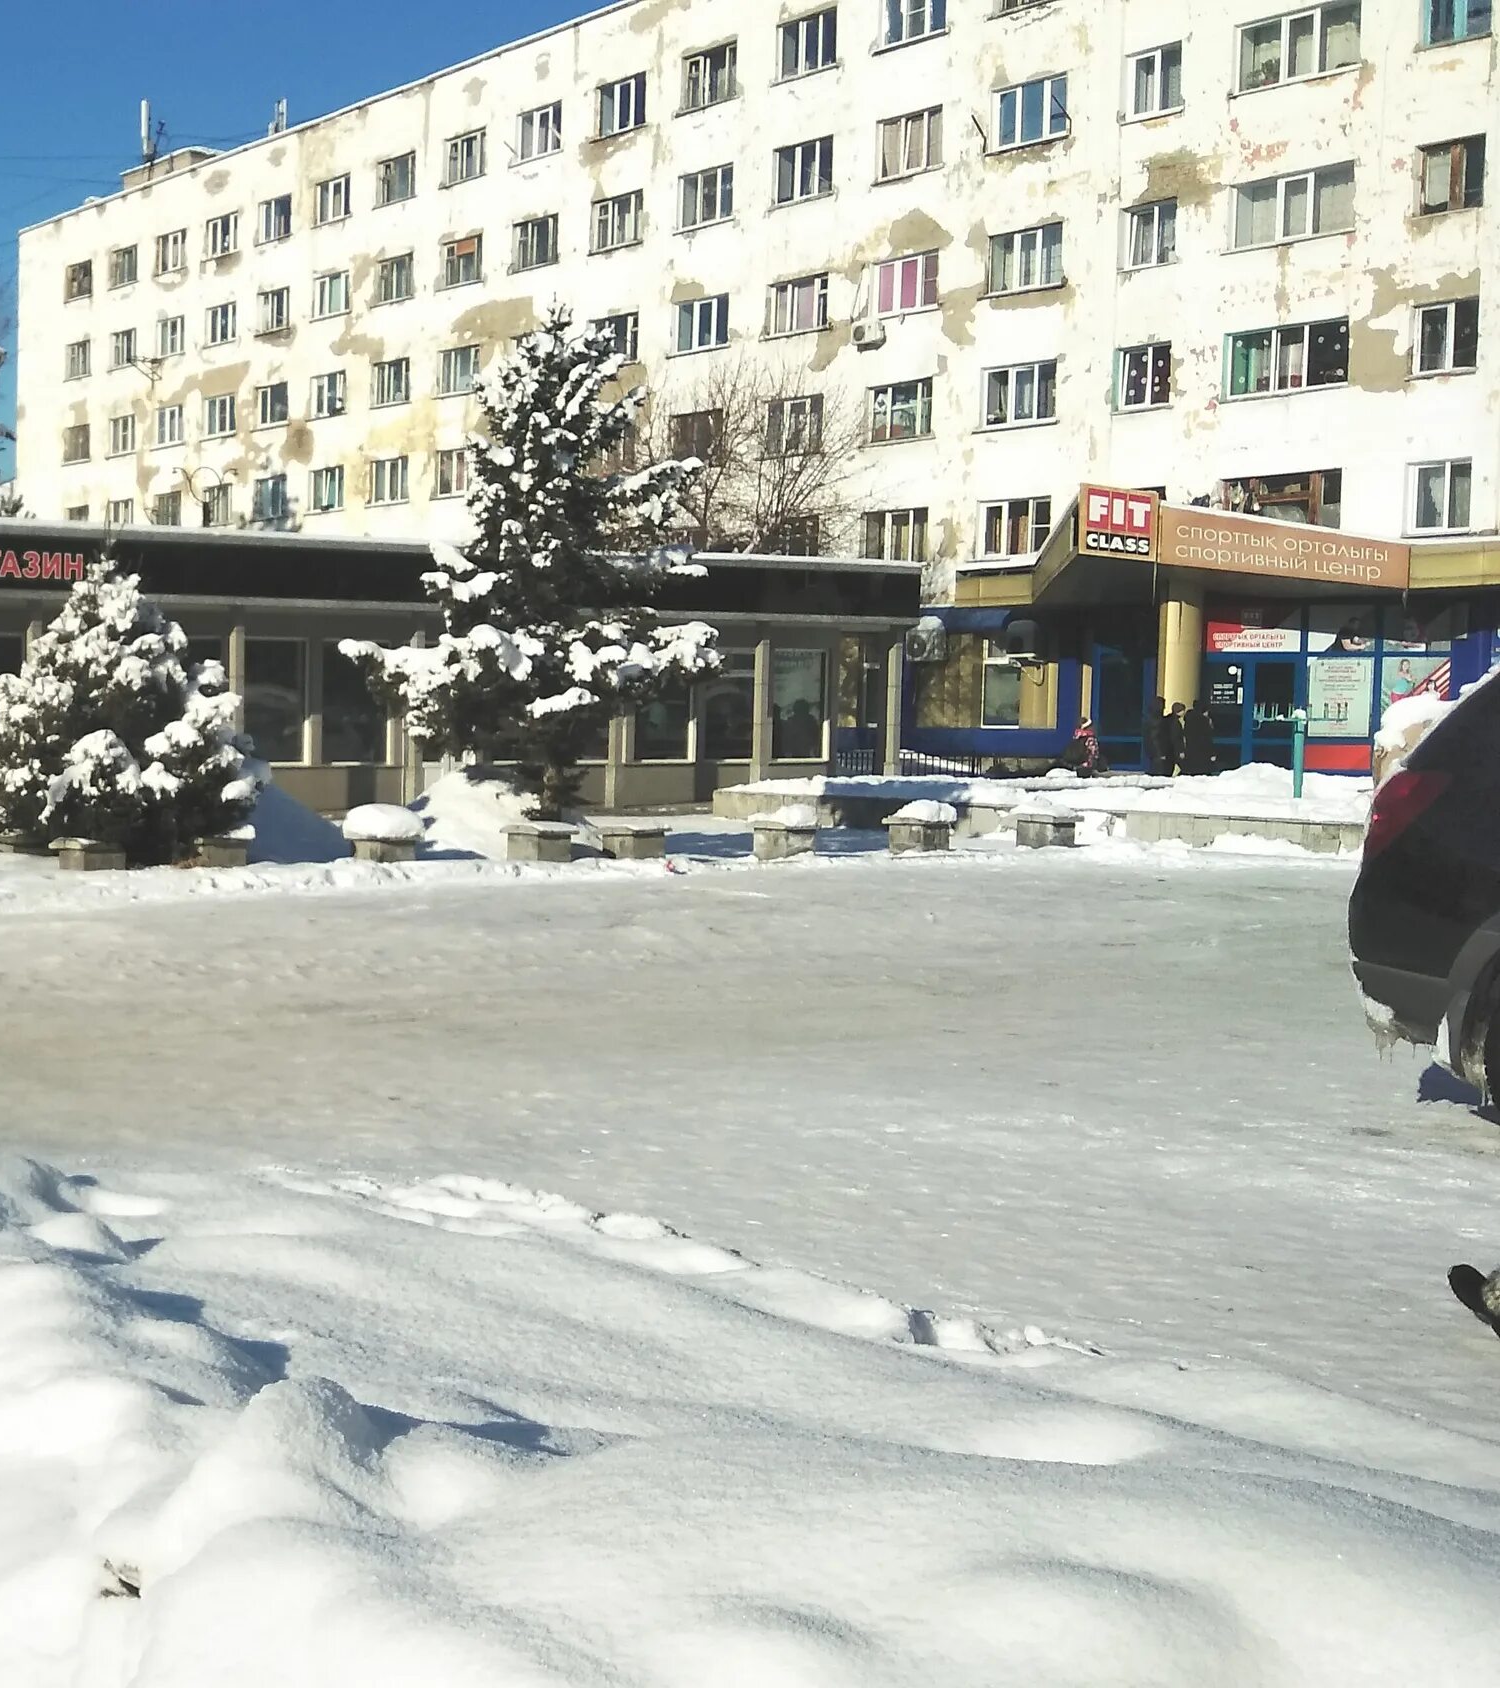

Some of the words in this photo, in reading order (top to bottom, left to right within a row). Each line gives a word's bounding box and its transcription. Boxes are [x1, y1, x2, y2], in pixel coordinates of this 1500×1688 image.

[1088, 494, 1151, 528] FIT
[1086, 532, 1150, 554] CLASS
[1175, 524, 1277, 551] спорттық
[1283, 537, 1389, 562] орталығы
[1174, 544, 1307, 572] спортивный
[1314, 560, 1382, 581] центр
